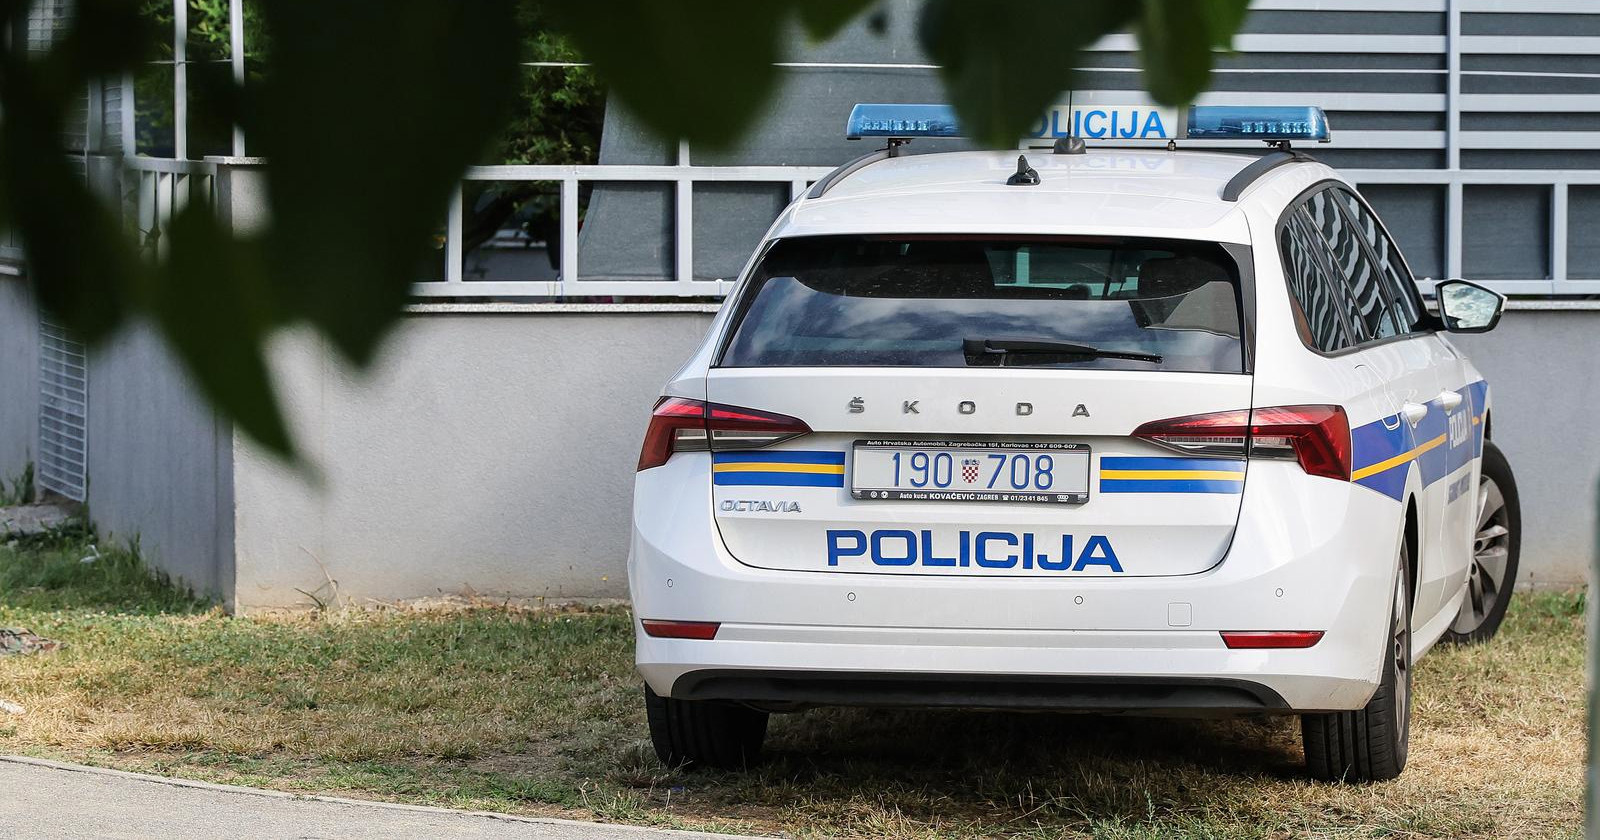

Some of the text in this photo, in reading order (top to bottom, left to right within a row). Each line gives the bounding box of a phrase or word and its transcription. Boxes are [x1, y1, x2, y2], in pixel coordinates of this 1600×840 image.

[1027, 110, 1147, 139] OLICIJA
[849, 396, 1091, 418] ŠKODA
[892, 452, 1054, 490] 190 708
[720, 500, 802, 513] OCTAVIA
[929, 492, 975, 500] KOVAČEVIĆ
[976, 493, 999, 501] ZAGREB
[826, 529, 1124, 573] POLICIJA
